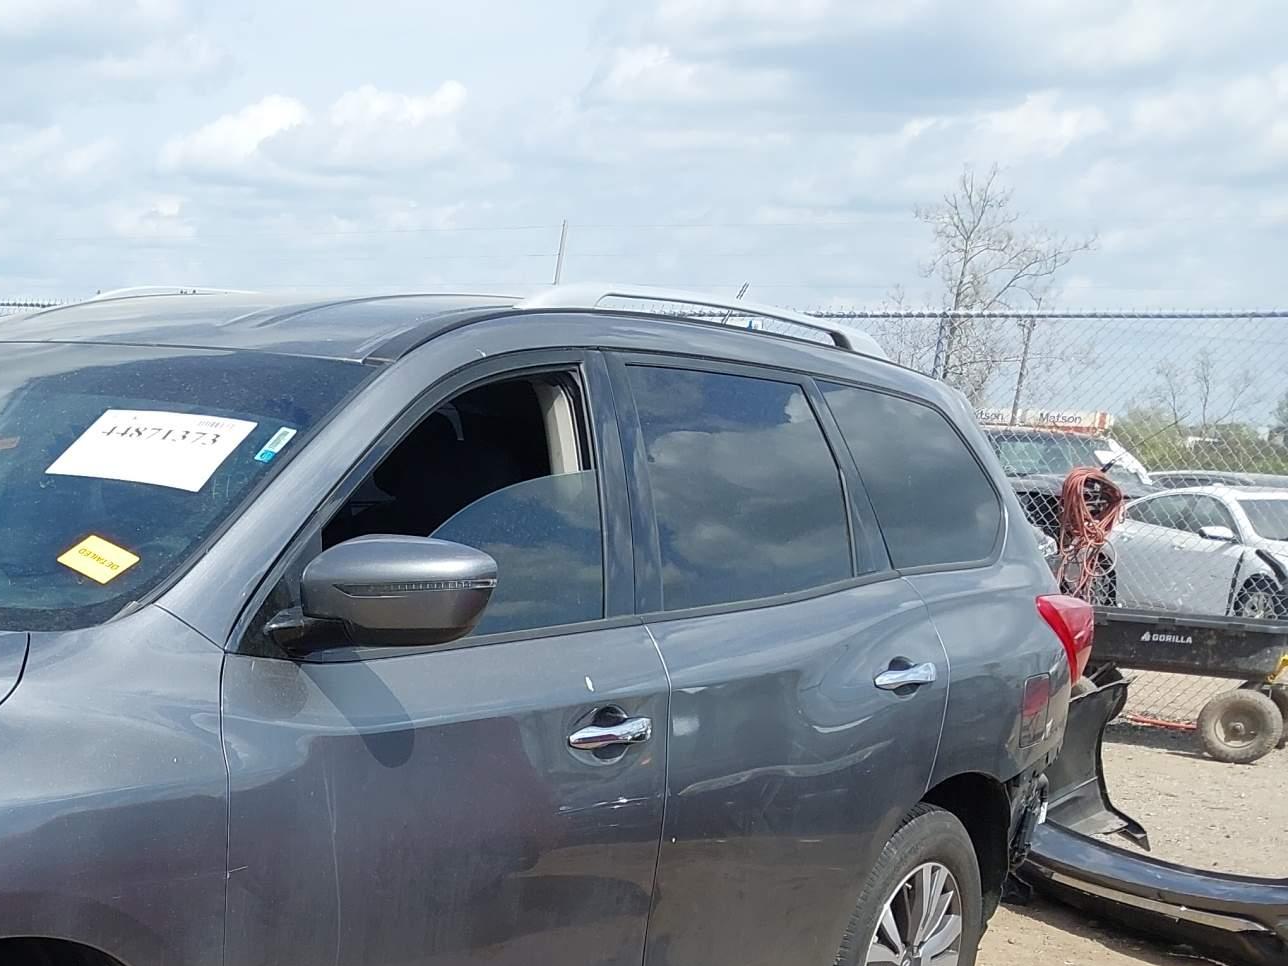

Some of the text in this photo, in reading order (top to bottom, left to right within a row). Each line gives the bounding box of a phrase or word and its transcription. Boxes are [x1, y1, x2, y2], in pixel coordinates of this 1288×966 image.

[1039, 412, 1082, 424] Matson
[102, 425, 221, 446] 44871373
[78, 548, 121, 571] DETAILED
[1152, 633, 1193, 644] GORILLA
